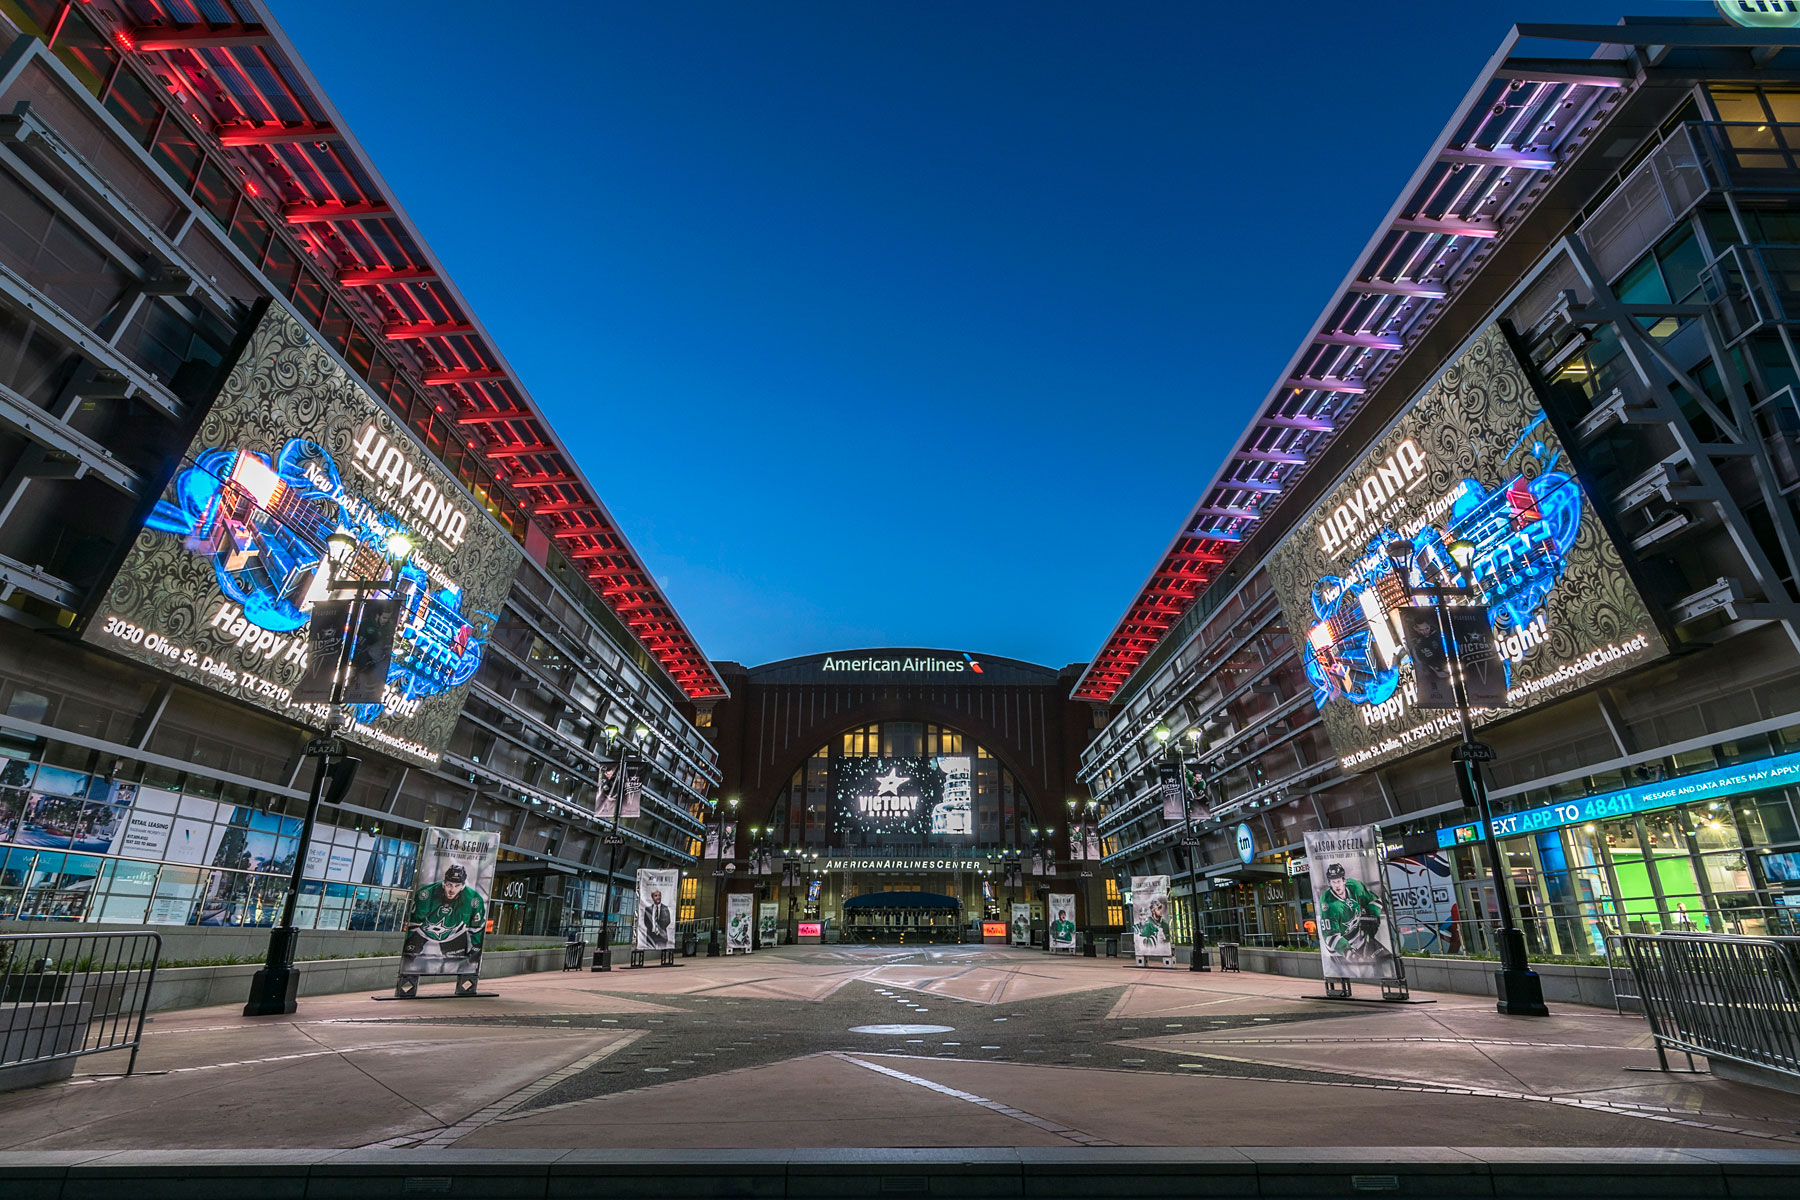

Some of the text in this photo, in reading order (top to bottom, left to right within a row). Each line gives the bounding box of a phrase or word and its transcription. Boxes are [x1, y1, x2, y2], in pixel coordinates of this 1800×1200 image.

[303, 463, 333, 492] New
[332, 487, 360, 516] Look
[362, 509, 387, 535] New
[353, 425, 467, 545] HAVANA
[1319, 440, 1426, 554] HAVANA
[376, 486, 410, 522] SOCIAL
[411, 520, 434, 542] CLUB
[1350, 497, 1407, 550] SOCIAL CLUB
[1402, 517, 1428, 540] New
[1426, 481, 1468, 522] Havana
[412, 549, 460, 597] New Havana
[1322, 586, 1341, 604] New
[1340, 568, 1360, 591] Look
[1360, 556, 1380, 574] New
[212, 602, 288, 660] Happy
[104, 616, 144, 644] 3030
[144, 633, 179, 660] Olive
[180, 647, 198, 667] St.
[200, 656, 236, 684] Dallas,
[239, 672, 256, 690] TX
[256, 679, 290, 704] 75219
[822, 657, 964, 672] American Airlines
[1362, 697, 1404, 726] Happy
[354, 722, 440, 764] www.HavanaSocialClub.net
[1342, 755, 1358, 768] 3030
[1357, 748, 1372, 763] Olive
[1371, 746, 1382, 758] St.
[1380, 738, 1402, 754] Dallas,
[1400, 732, 1412, 744] TX
[1412, 722, 1434, 742] 75219
[859, 796, 918, 812] VICTORY
[1642, 765, 1800, 802] MESSAGE AND DATA RATES MAY APPLY
[131, 818, 168, 830] RETAIL LEASING
[1492, 793, 1634, 836] EXT APP TO 48411
[436, 838, 490, 853] TYLER SEGUIN
[1239, 837, 1250, 850] tm
[1314, 838, 1364, 852] JASON SPEZZA
[1433, 890, 1448, 902] HD
